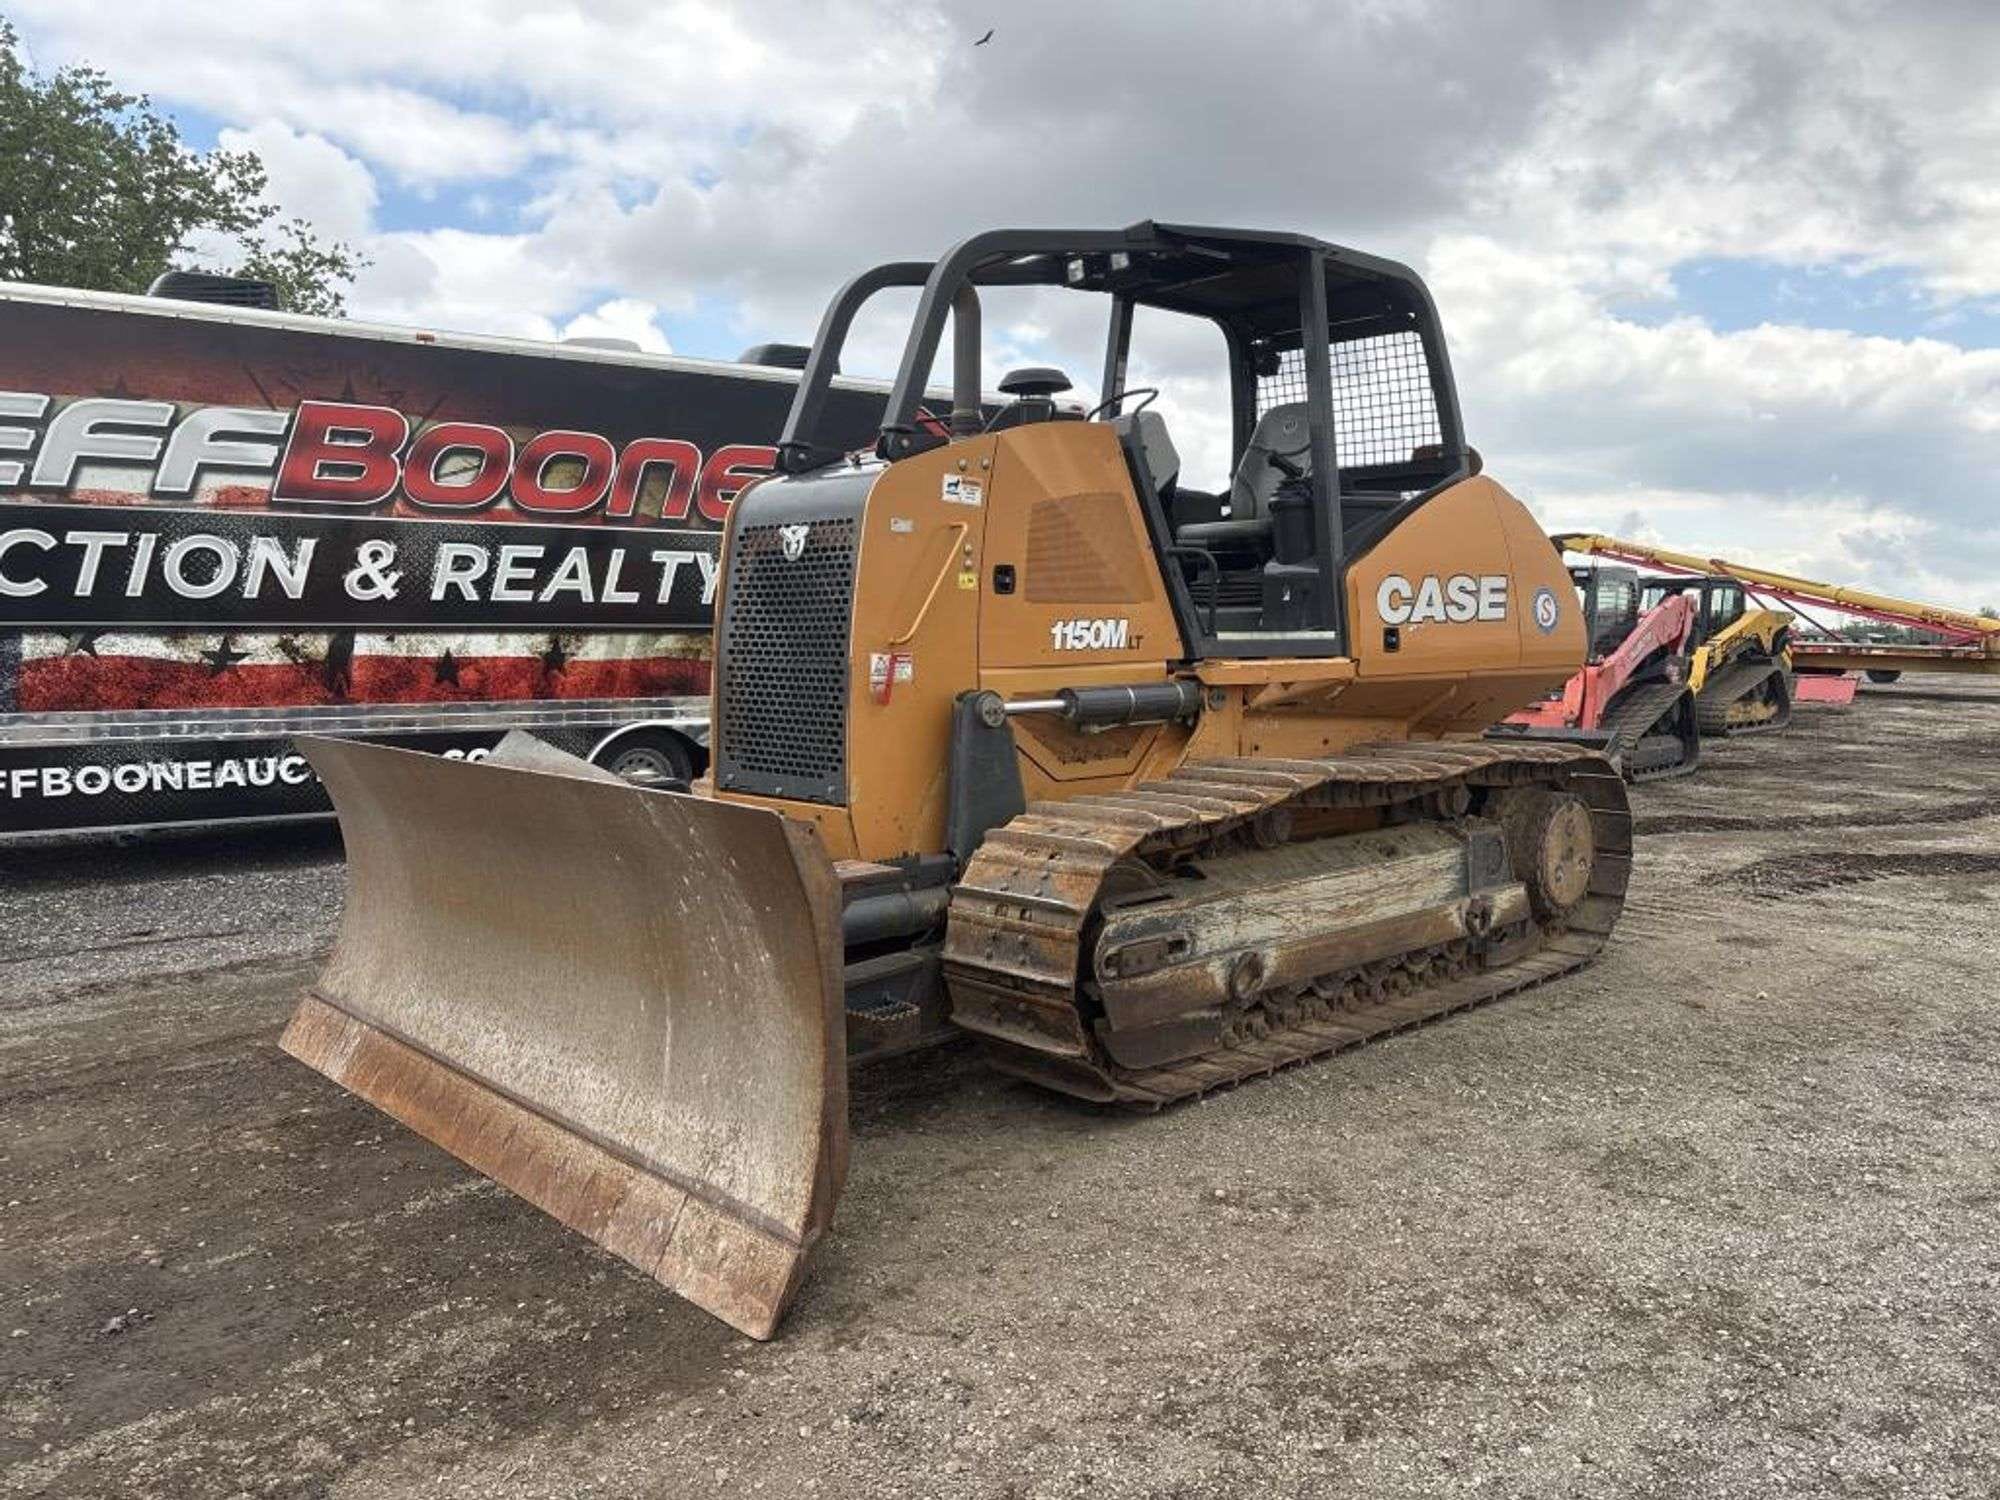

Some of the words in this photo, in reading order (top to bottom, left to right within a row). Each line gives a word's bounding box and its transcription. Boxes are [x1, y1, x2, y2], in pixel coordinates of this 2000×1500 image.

[0, 529, 319, 599] CTION
[344, 539, 401, 600] &
[430, 543, 720, 604] REALTY
[1377, 574, 1508, 625] CASE
